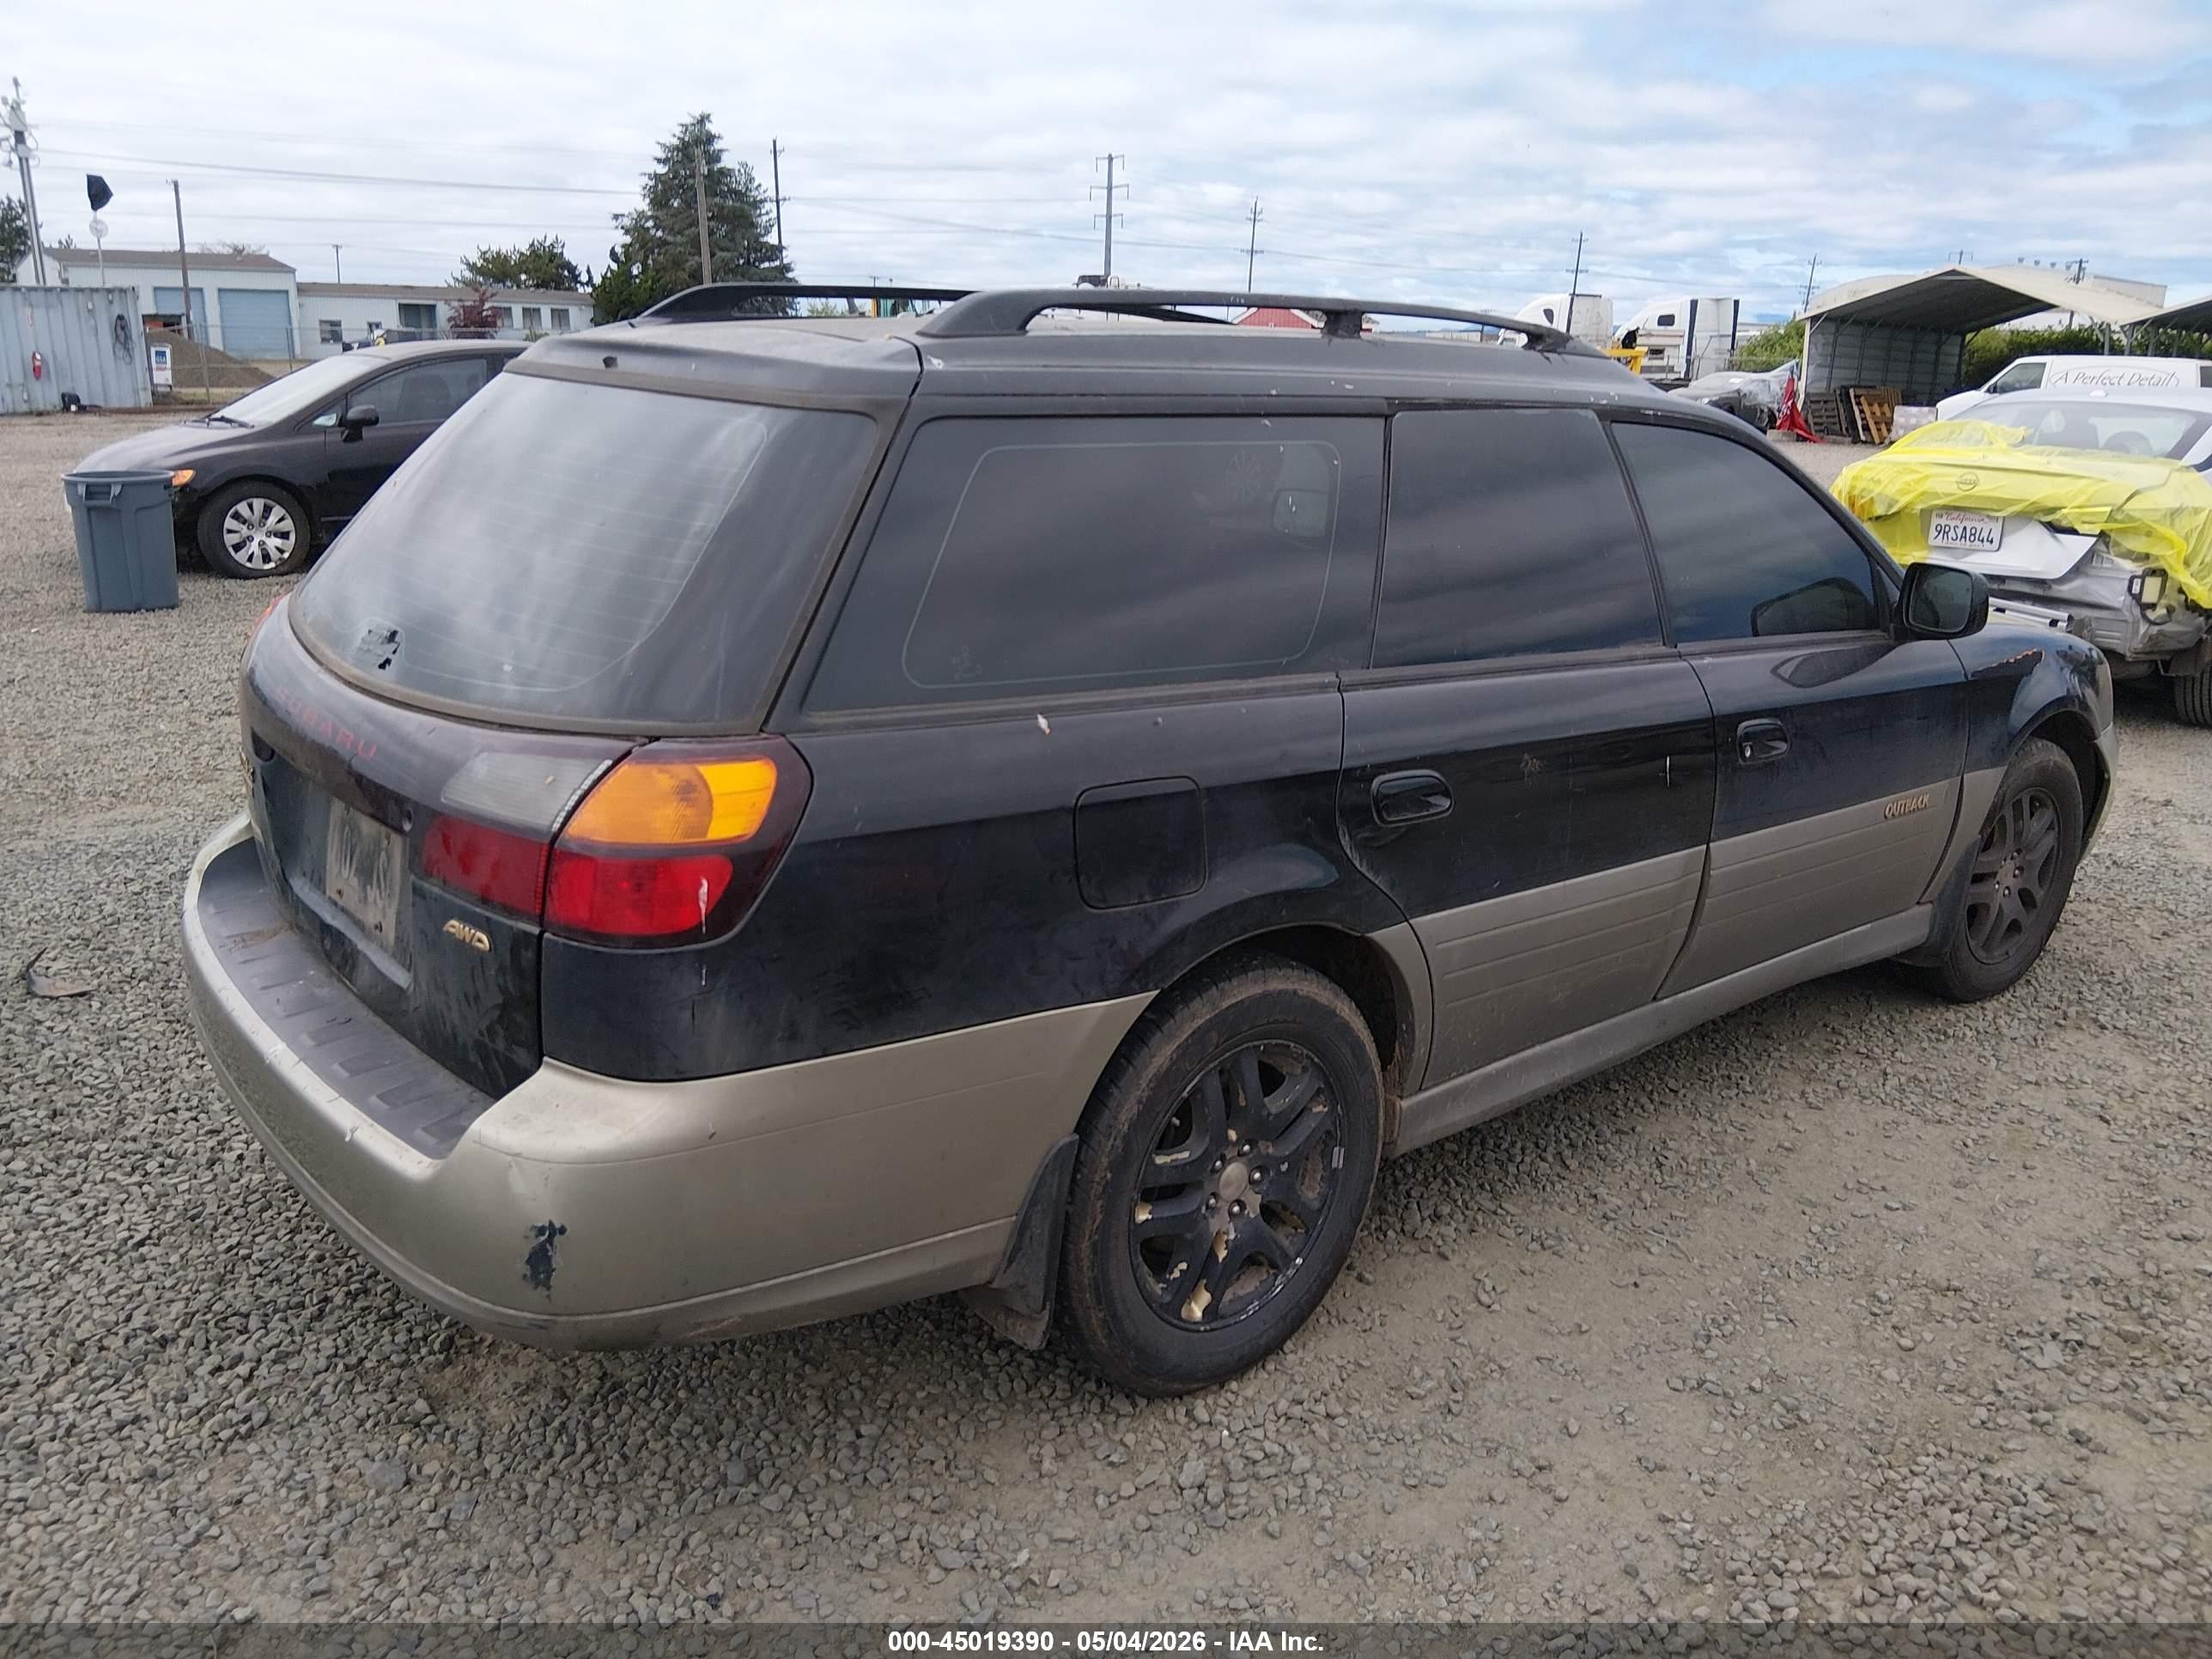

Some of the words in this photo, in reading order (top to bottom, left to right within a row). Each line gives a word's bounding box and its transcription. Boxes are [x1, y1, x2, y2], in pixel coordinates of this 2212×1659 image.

[2055, 371, 2069, 386] A
[2073, 368, 2125, 386] Perfect
[2128, 371, 2177, 387] Detail
[1933, 523, 1994, 545] 9RSA844
[1883, 792, 1930, 820] OUTBACK
[442, 919, 491, 952] AWD
